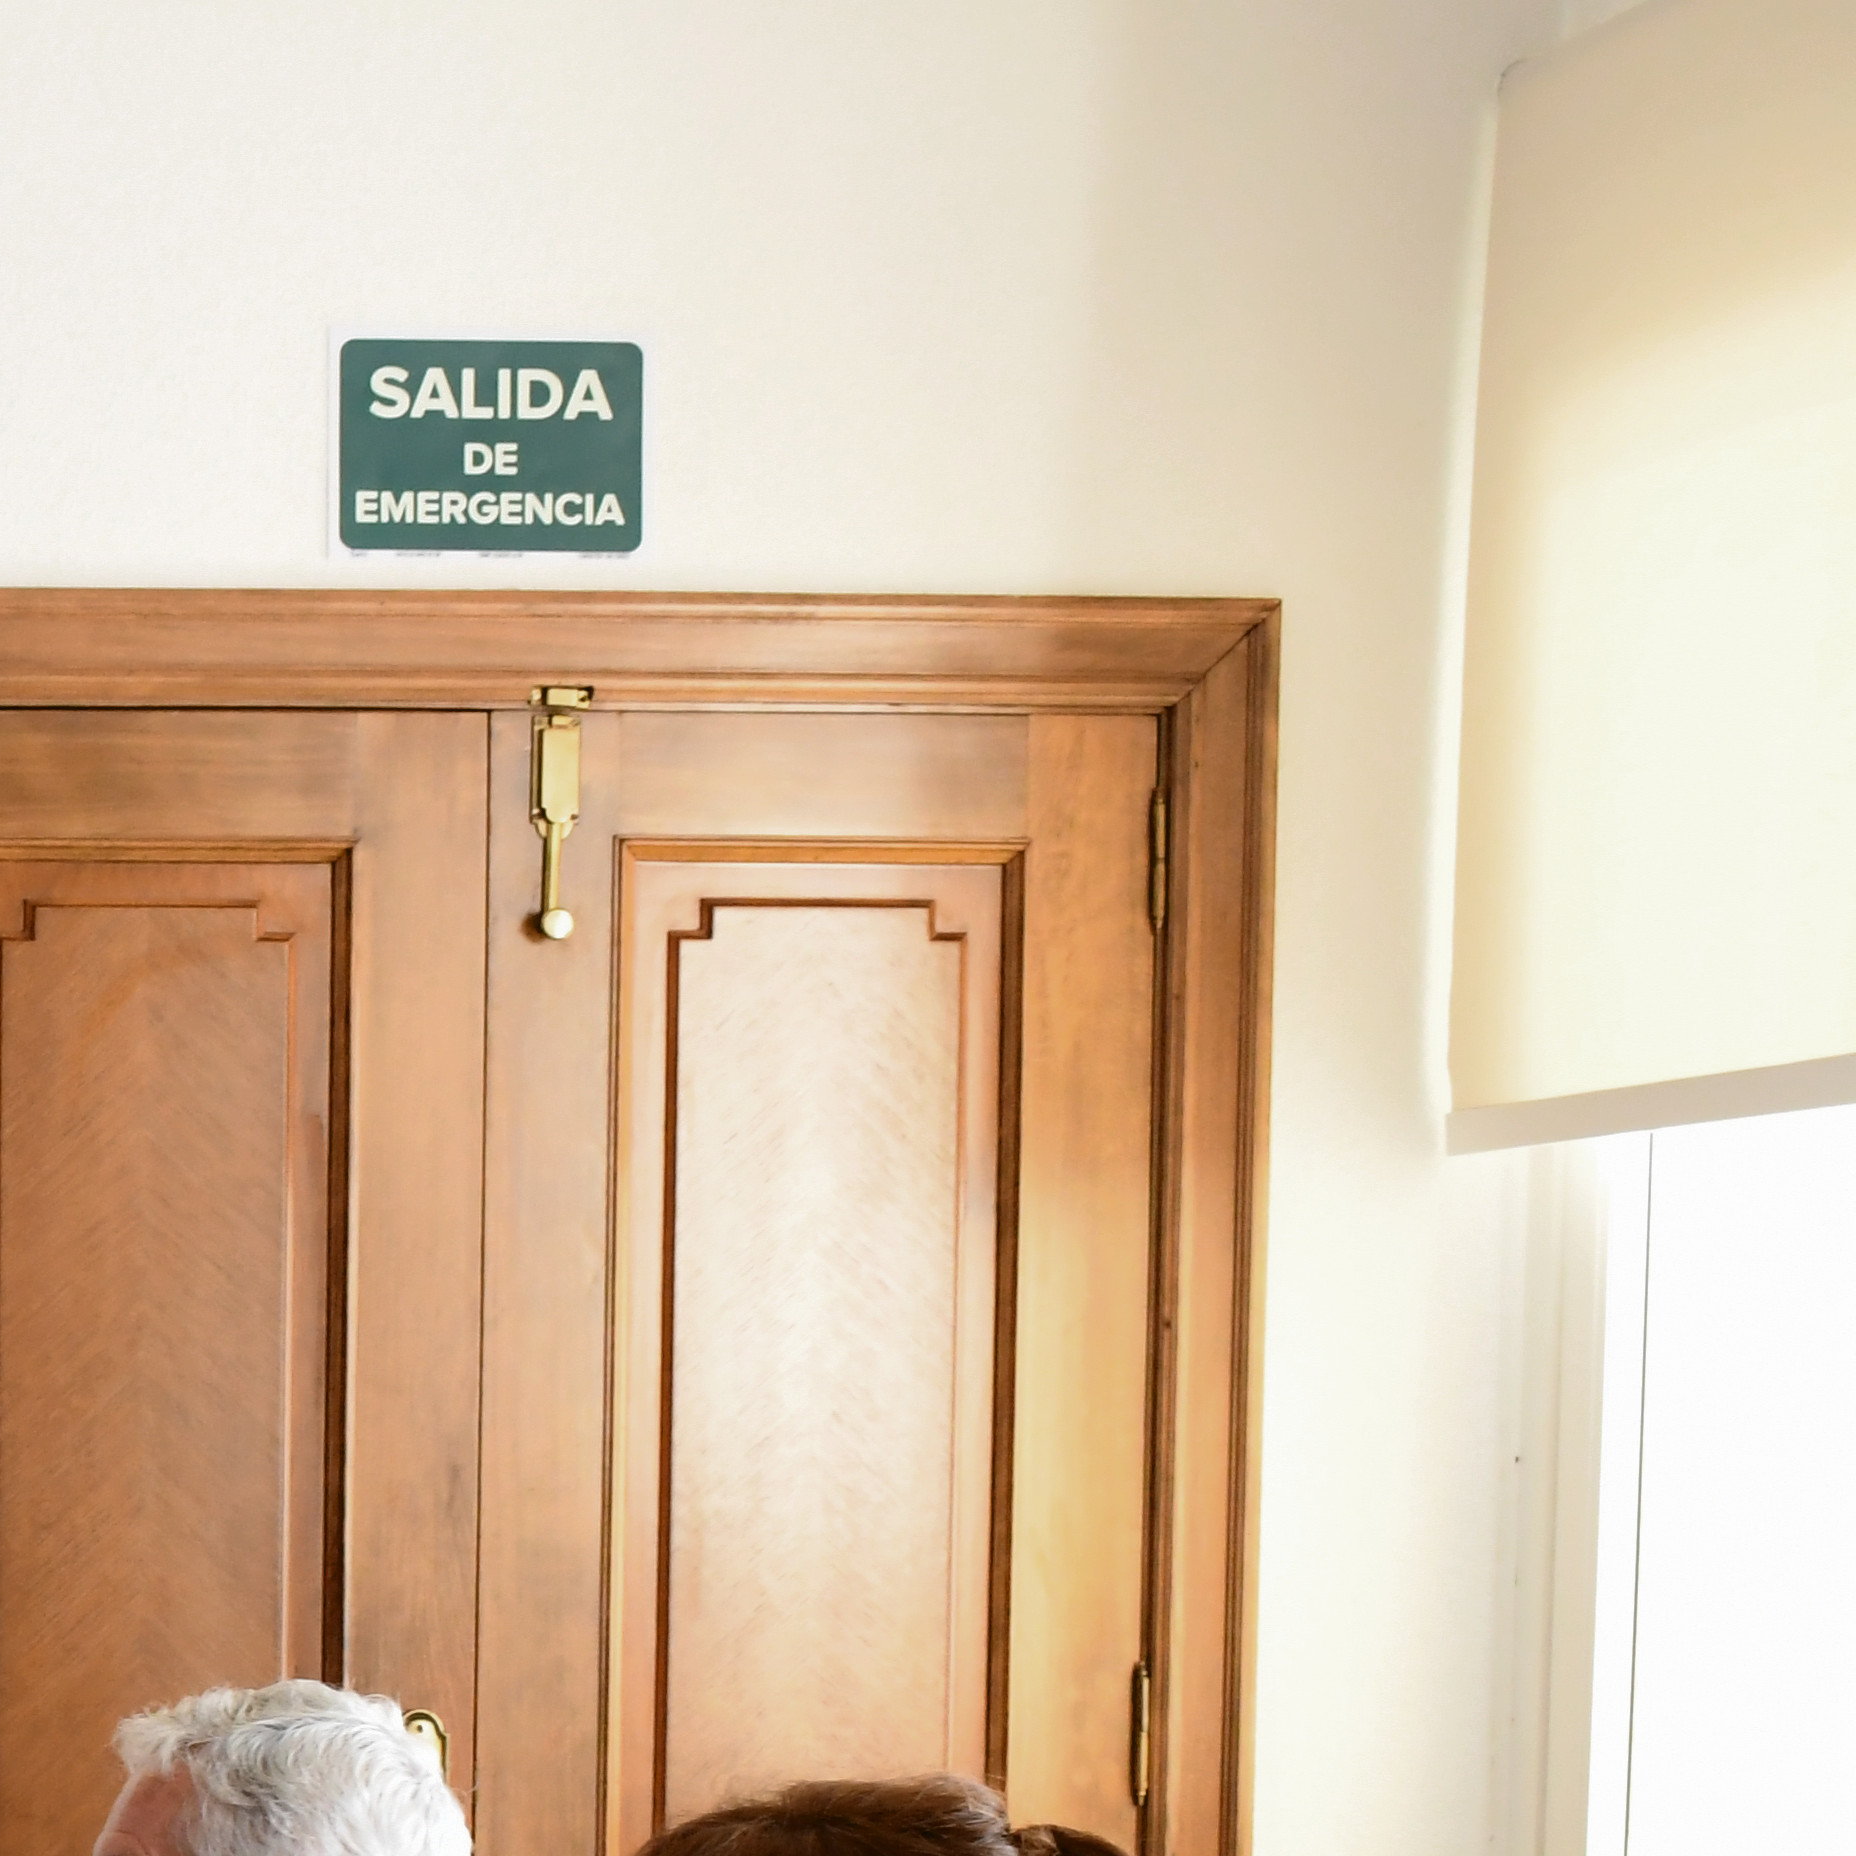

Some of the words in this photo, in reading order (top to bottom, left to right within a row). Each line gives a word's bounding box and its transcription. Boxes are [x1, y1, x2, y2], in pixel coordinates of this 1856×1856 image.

[369, 366, 614, 421] SALIDA
[463, 442, 519, 476] DE
[354, 490, 626, 526] EMERGENCIA
